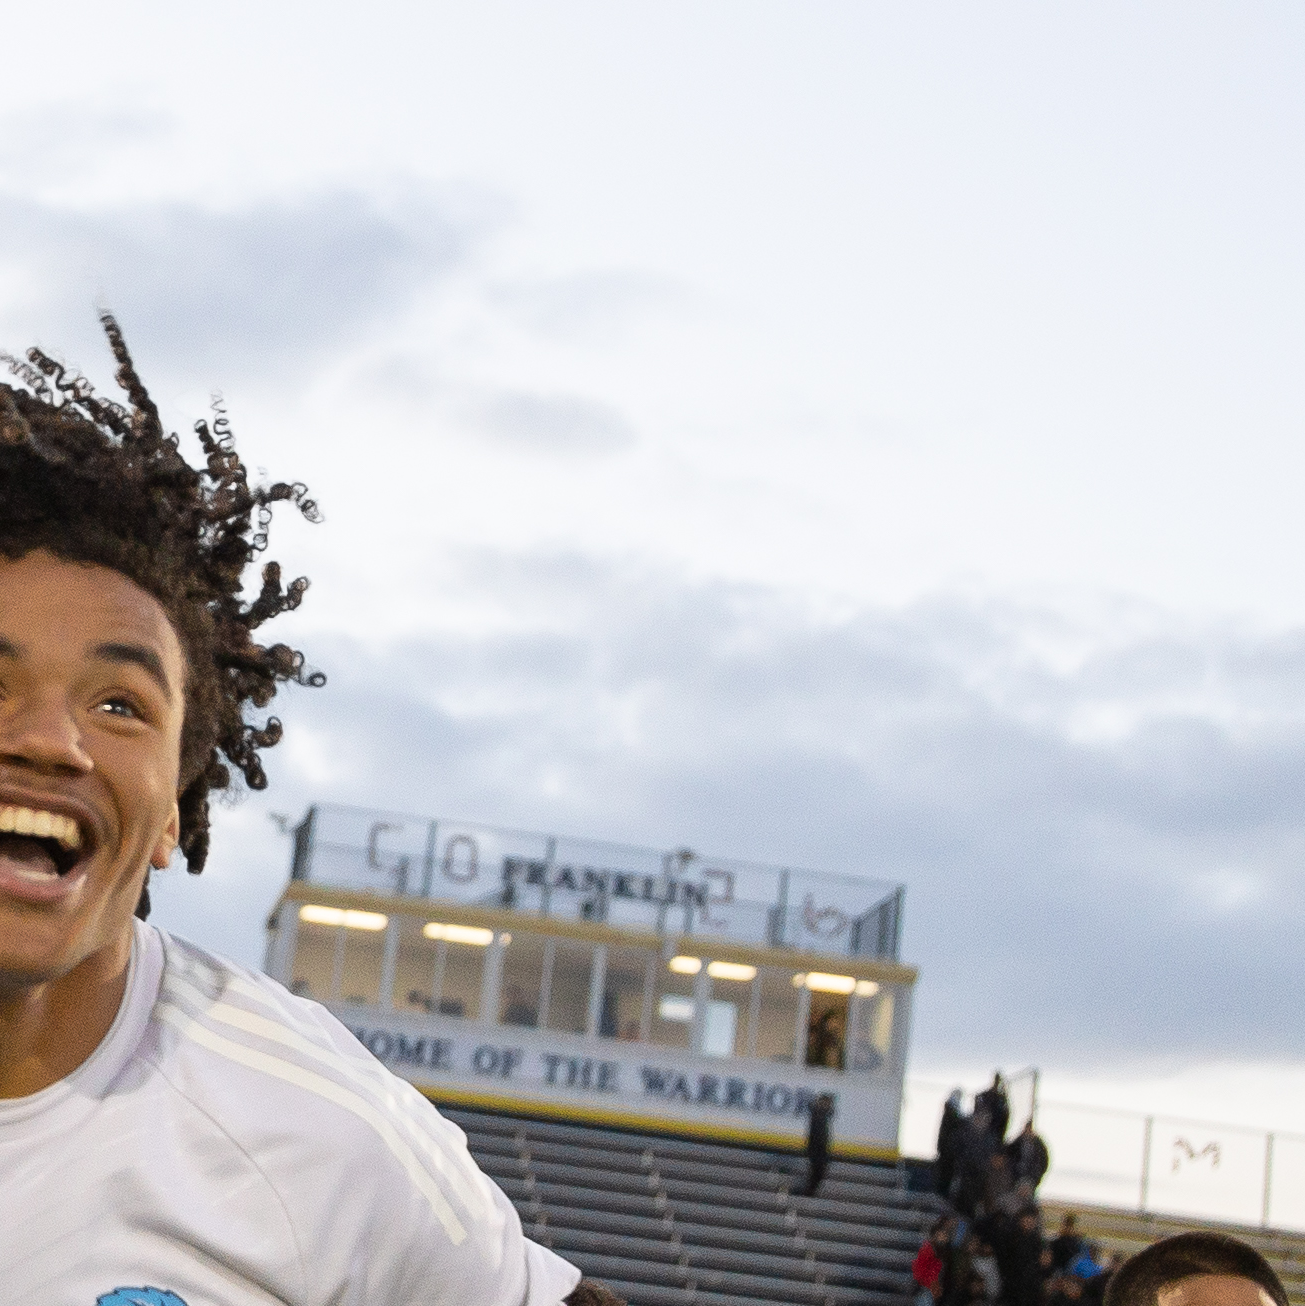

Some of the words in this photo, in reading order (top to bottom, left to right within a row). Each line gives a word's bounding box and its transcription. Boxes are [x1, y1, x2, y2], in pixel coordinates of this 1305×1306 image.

[502, 854, 710, 908] FRANKLIN
[470, 1045, 519, 1081] OF
[542, 1054, 619, 1093] THE
[641, 1063, 831, 1118] WARRIOR
